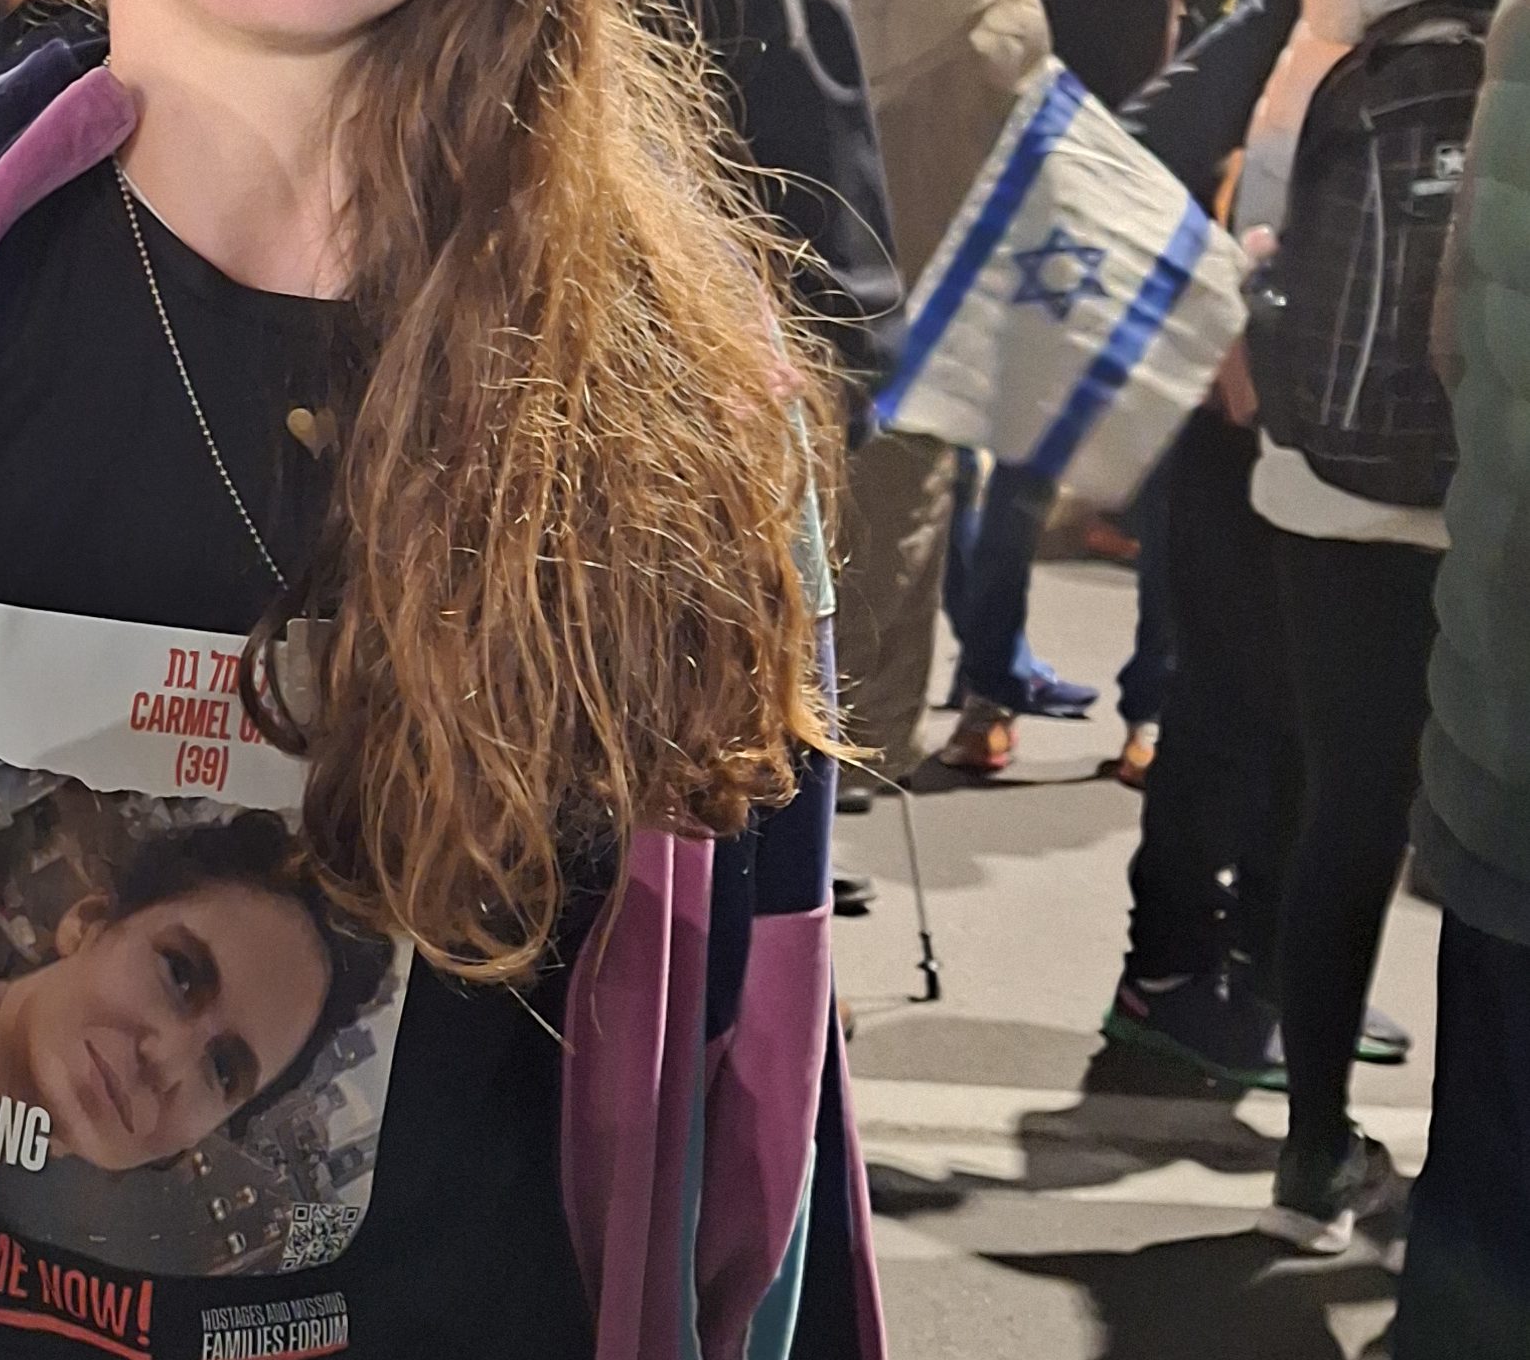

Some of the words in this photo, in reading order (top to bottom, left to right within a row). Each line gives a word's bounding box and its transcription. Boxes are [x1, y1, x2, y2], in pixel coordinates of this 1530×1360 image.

[164, 648, 200, 690] גת
[130, 691, 232, 741] CARMEL
[175, 741, 229, 792] (39)
[38, 1258, 153, 1347] NOW!
[201, 1305, 266, 1331] HOSTAGES
[266, 1300, 291, 1324] AND
[290, 1291, 347, 1320] MISSING
[202, 1325, 284, 1360] FAMILIES
[287, 1314, 349, 1352] FORUM
